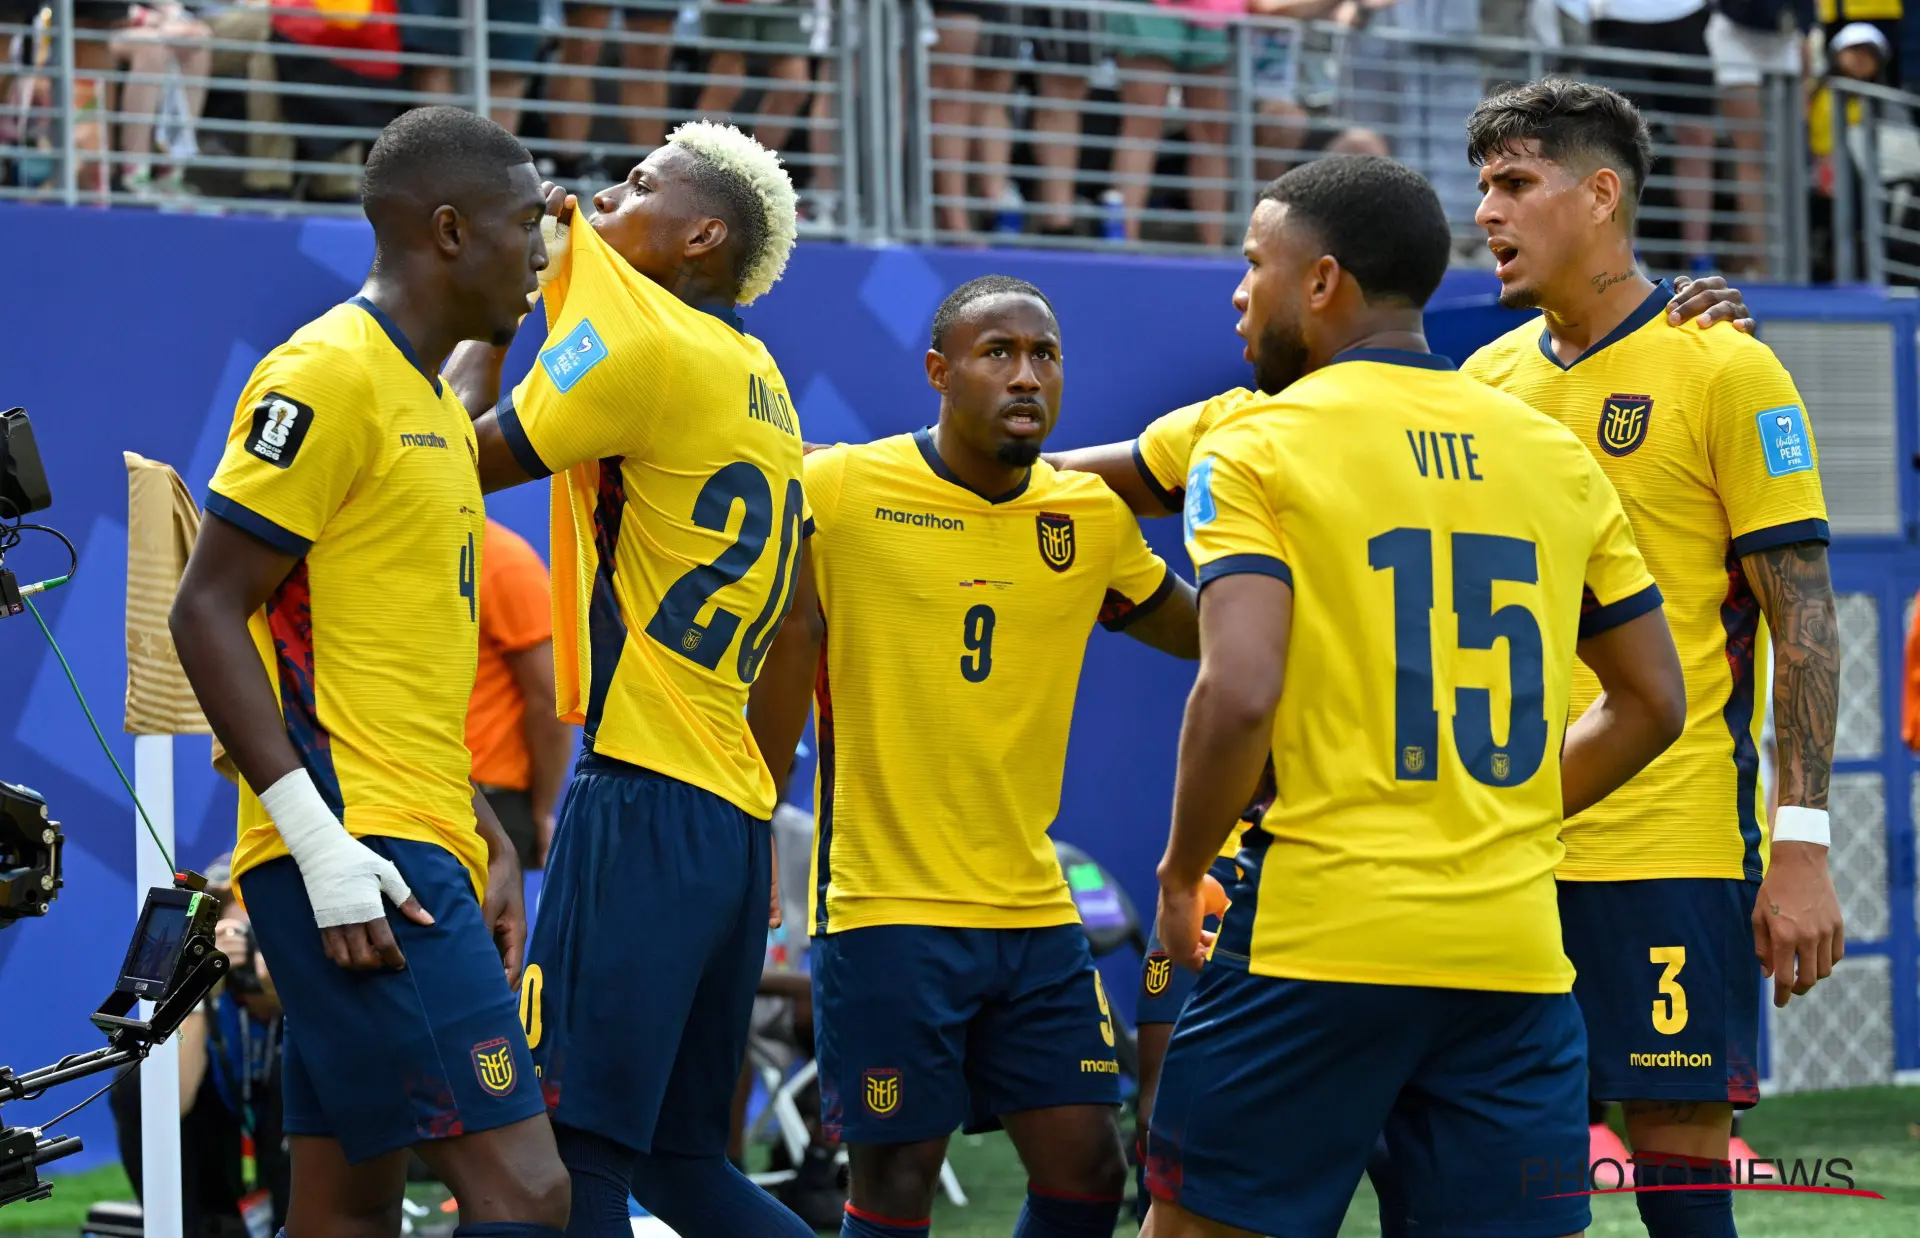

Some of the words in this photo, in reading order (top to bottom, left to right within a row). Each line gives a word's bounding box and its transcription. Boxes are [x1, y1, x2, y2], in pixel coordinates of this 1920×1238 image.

[253, 443, 281, 461] 2026
[1406, 429, 1484, 481] VITE
[875, 507, 964, 531] marathon
[459, 531, 475, 622] 4
[644, 461, 804, 684] 20
[960, 603, 996, 683] 9
[1368, 527, 1548, 788] 15
[519, 963, 543, 1049] 0
[1094, 969, 1115, 1047] 9
[1649, 945, 1689, 1035] 3
[1630, 1050, 1712, 1067] marathon
